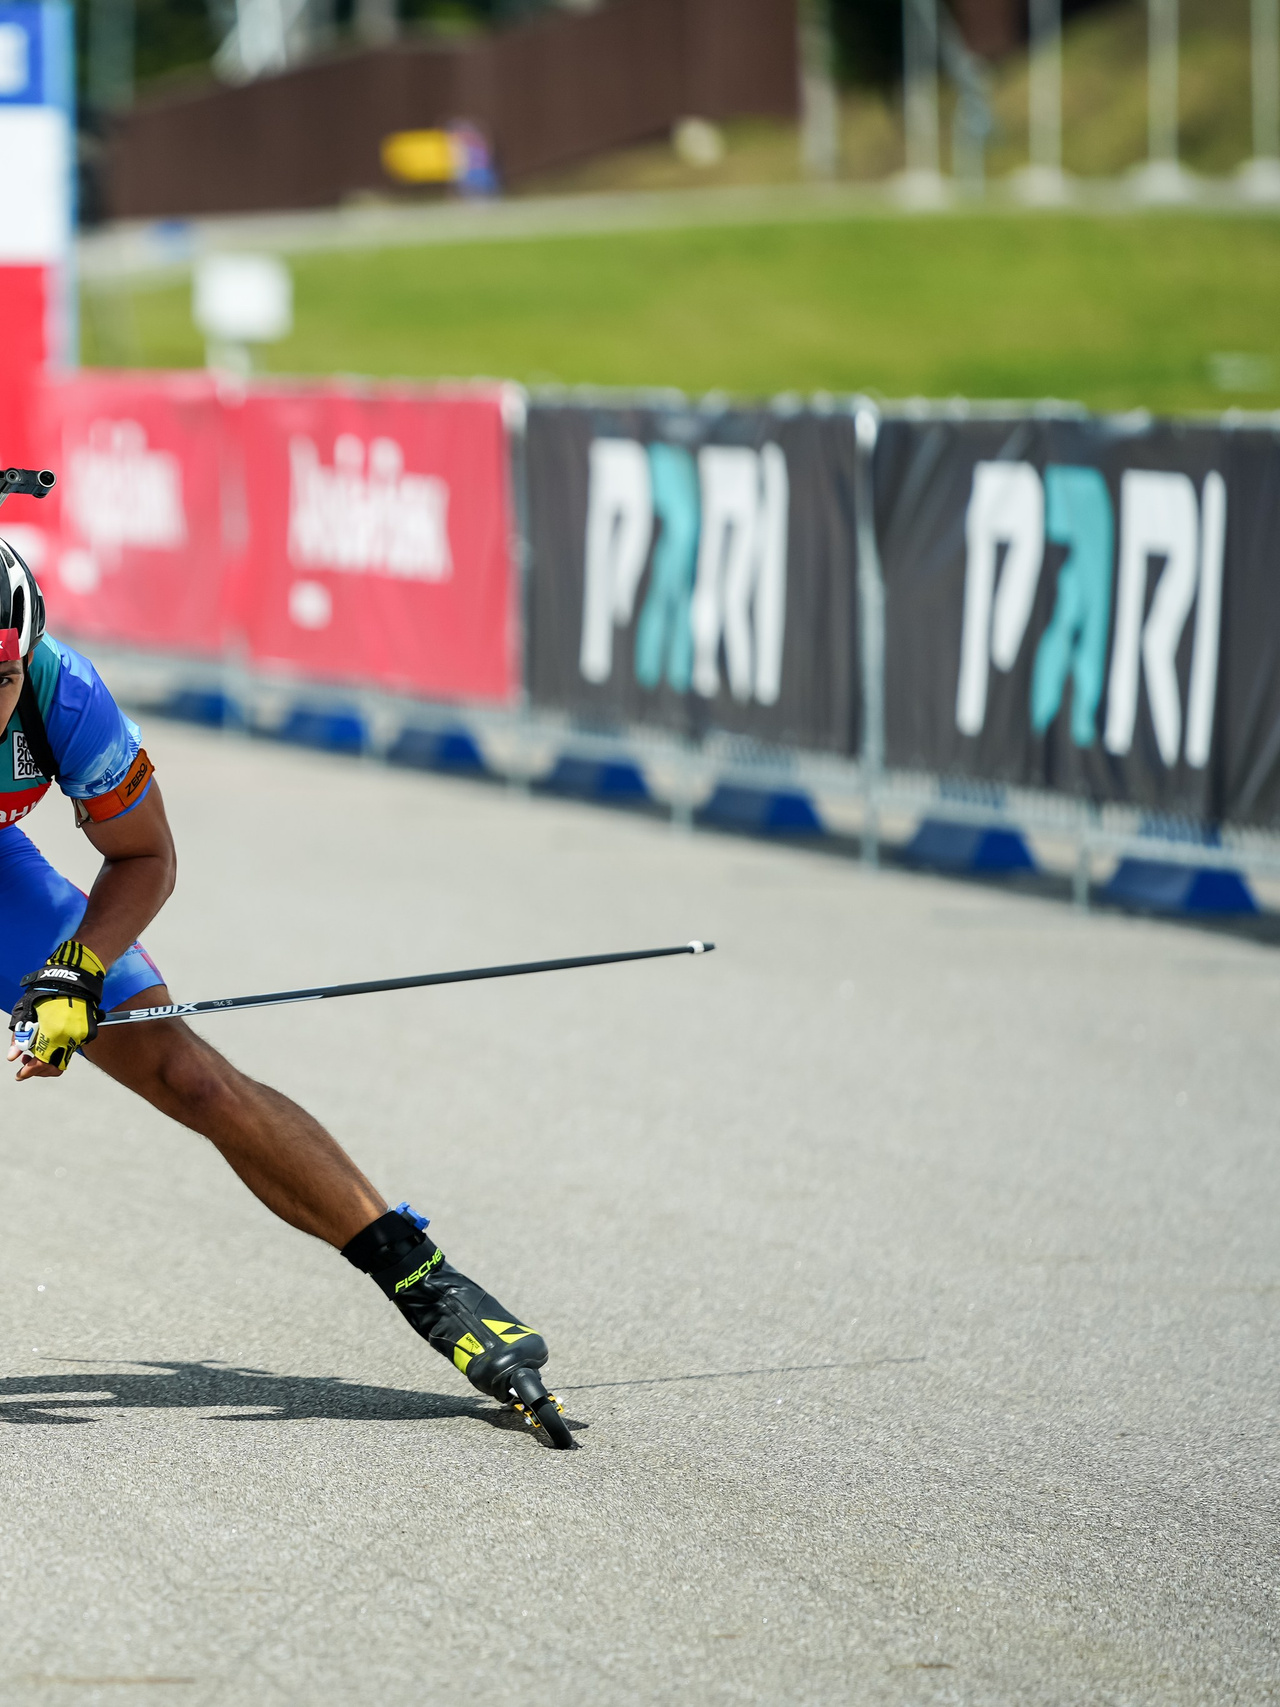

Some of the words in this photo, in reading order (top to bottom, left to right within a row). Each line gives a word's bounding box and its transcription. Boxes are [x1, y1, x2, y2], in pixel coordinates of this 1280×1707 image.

[580, 439, 789, 706] PARI
[955, 460, 1227, 769] PARI
[125, 762, 148, 797] ZERO
[395, 1248, 444, 1293] FISCHE
